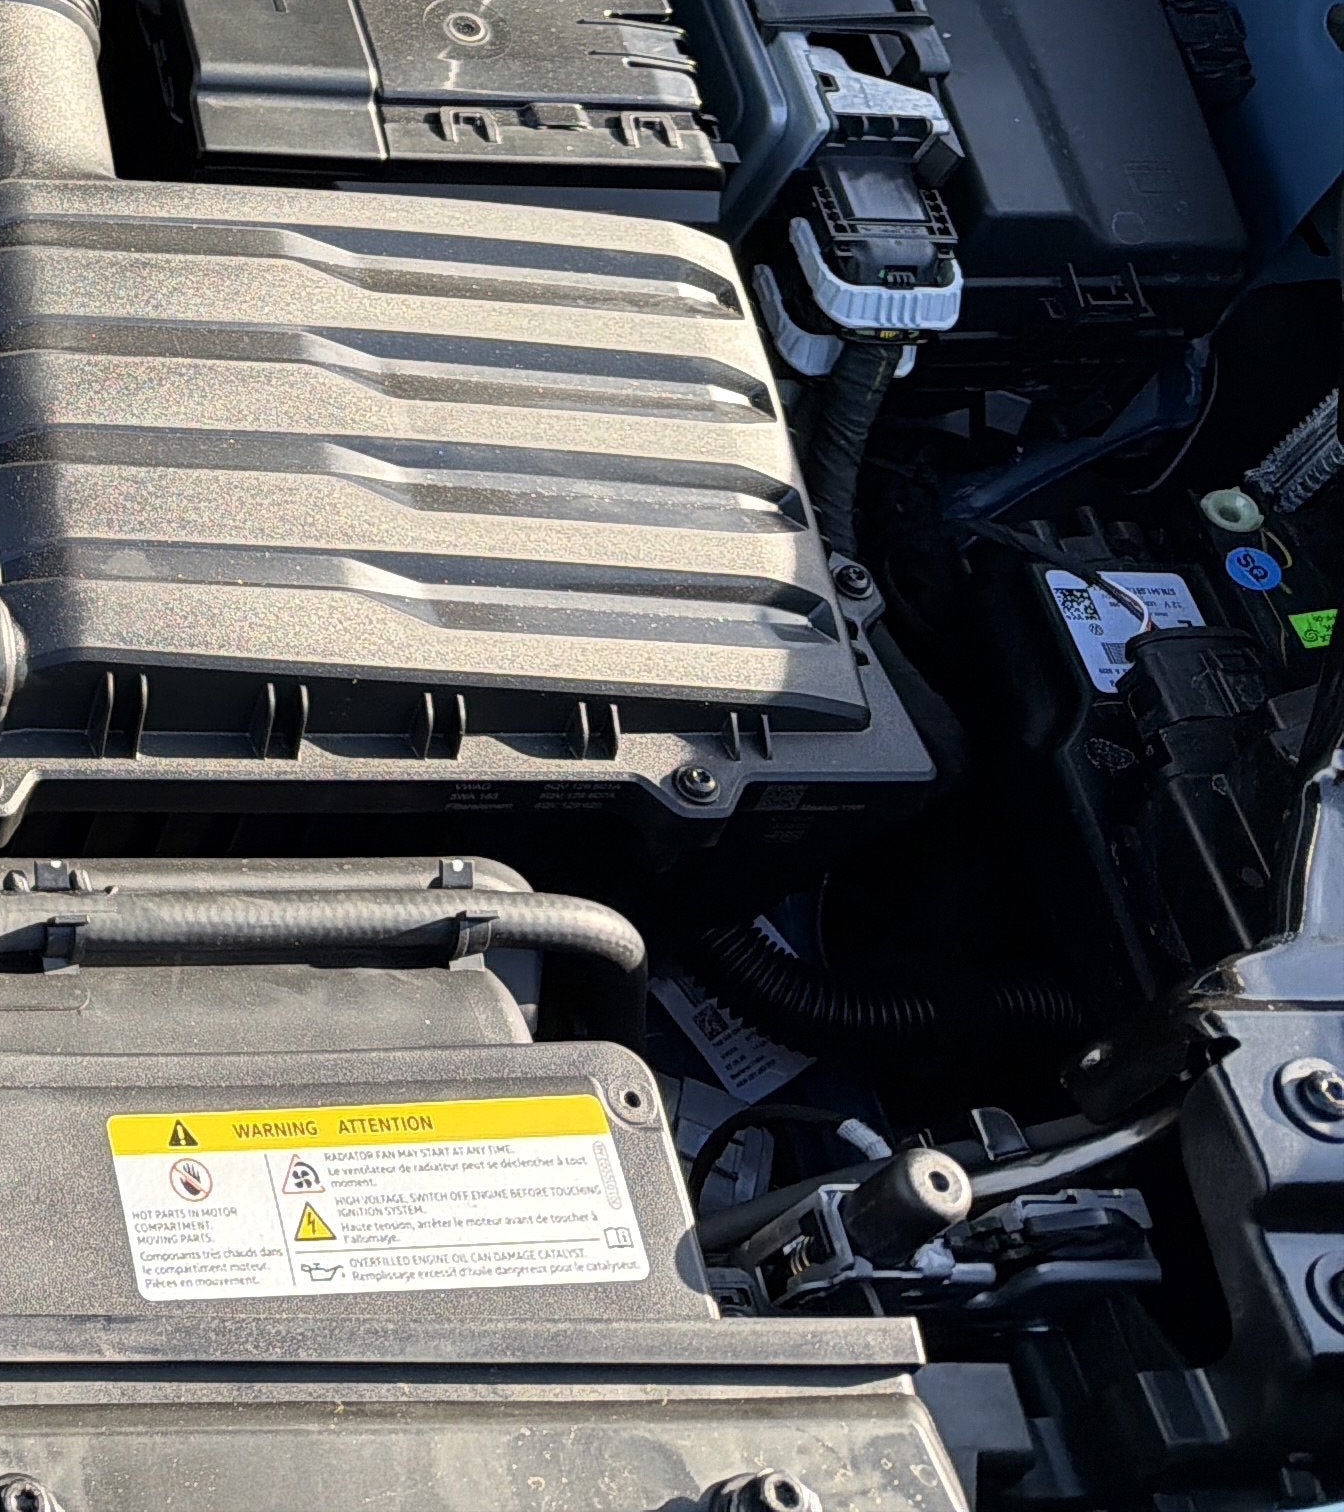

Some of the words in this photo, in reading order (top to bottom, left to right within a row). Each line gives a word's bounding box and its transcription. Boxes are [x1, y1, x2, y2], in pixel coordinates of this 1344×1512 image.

[232, 1119, 318, 1140] WARNING
[338, 1115, 434, 1135] ATTENTION
[324, 1151, 373, 1162] RADIATOR
[375, 1149, 395, 1159] FAN
[397, 1148, 417, 1158] MAY
[420, 1147, 450, 1158] START
[452, 1146, 463, 1156] AT
[466, 1145, 485, 1155] ANY
[328, 1167, 340, 1176] Le
[399, 1163, 411, 1172] de
[335, 1195, 360, 1206] HIGH
[411, 1191, 447, 1203] SWITCH
[450, 1190, 468, 1201] OFF
[132, 1210, 153, 1220] HOT
[155, 1208, 186, 1219] PARTS
[188, 1208, 200, 1218] IN
[201, 1206, 238, 1217] MOTOR
[137, 1234, 178, 1245] MOVING
[140, 1249, 201, 1262] Composants
[349, 1256, 410, 1268] OVERFILLED
[413, 1254, 449, 1266] ENGINE
